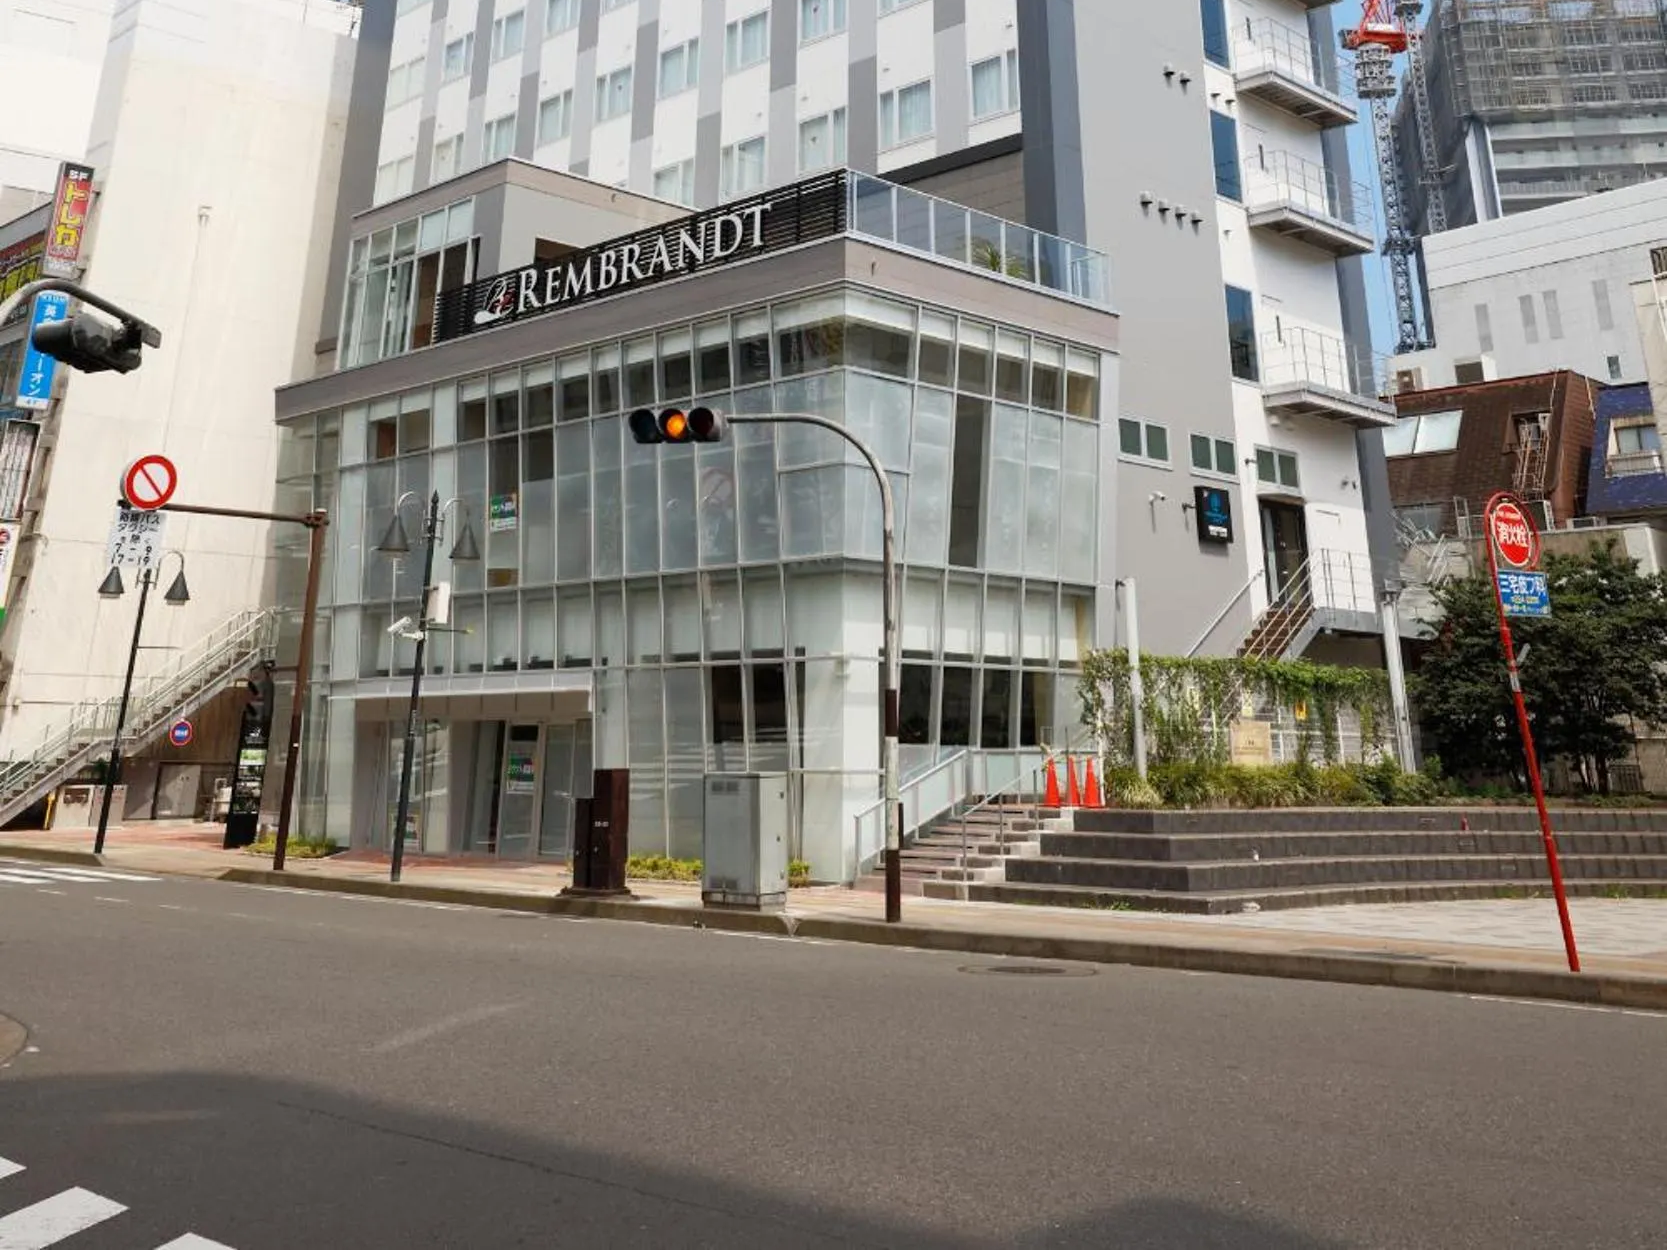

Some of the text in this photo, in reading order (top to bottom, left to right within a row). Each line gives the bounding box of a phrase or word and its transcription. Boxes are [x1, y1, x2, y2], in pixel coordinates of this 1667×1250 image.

[55, 181, 88, 247] トレカ
[516, 203, 772, 314] REMBRANDT
[117, 523, 159, 534] タクシー
[1496, 521, 1528, 548] 消火栓
